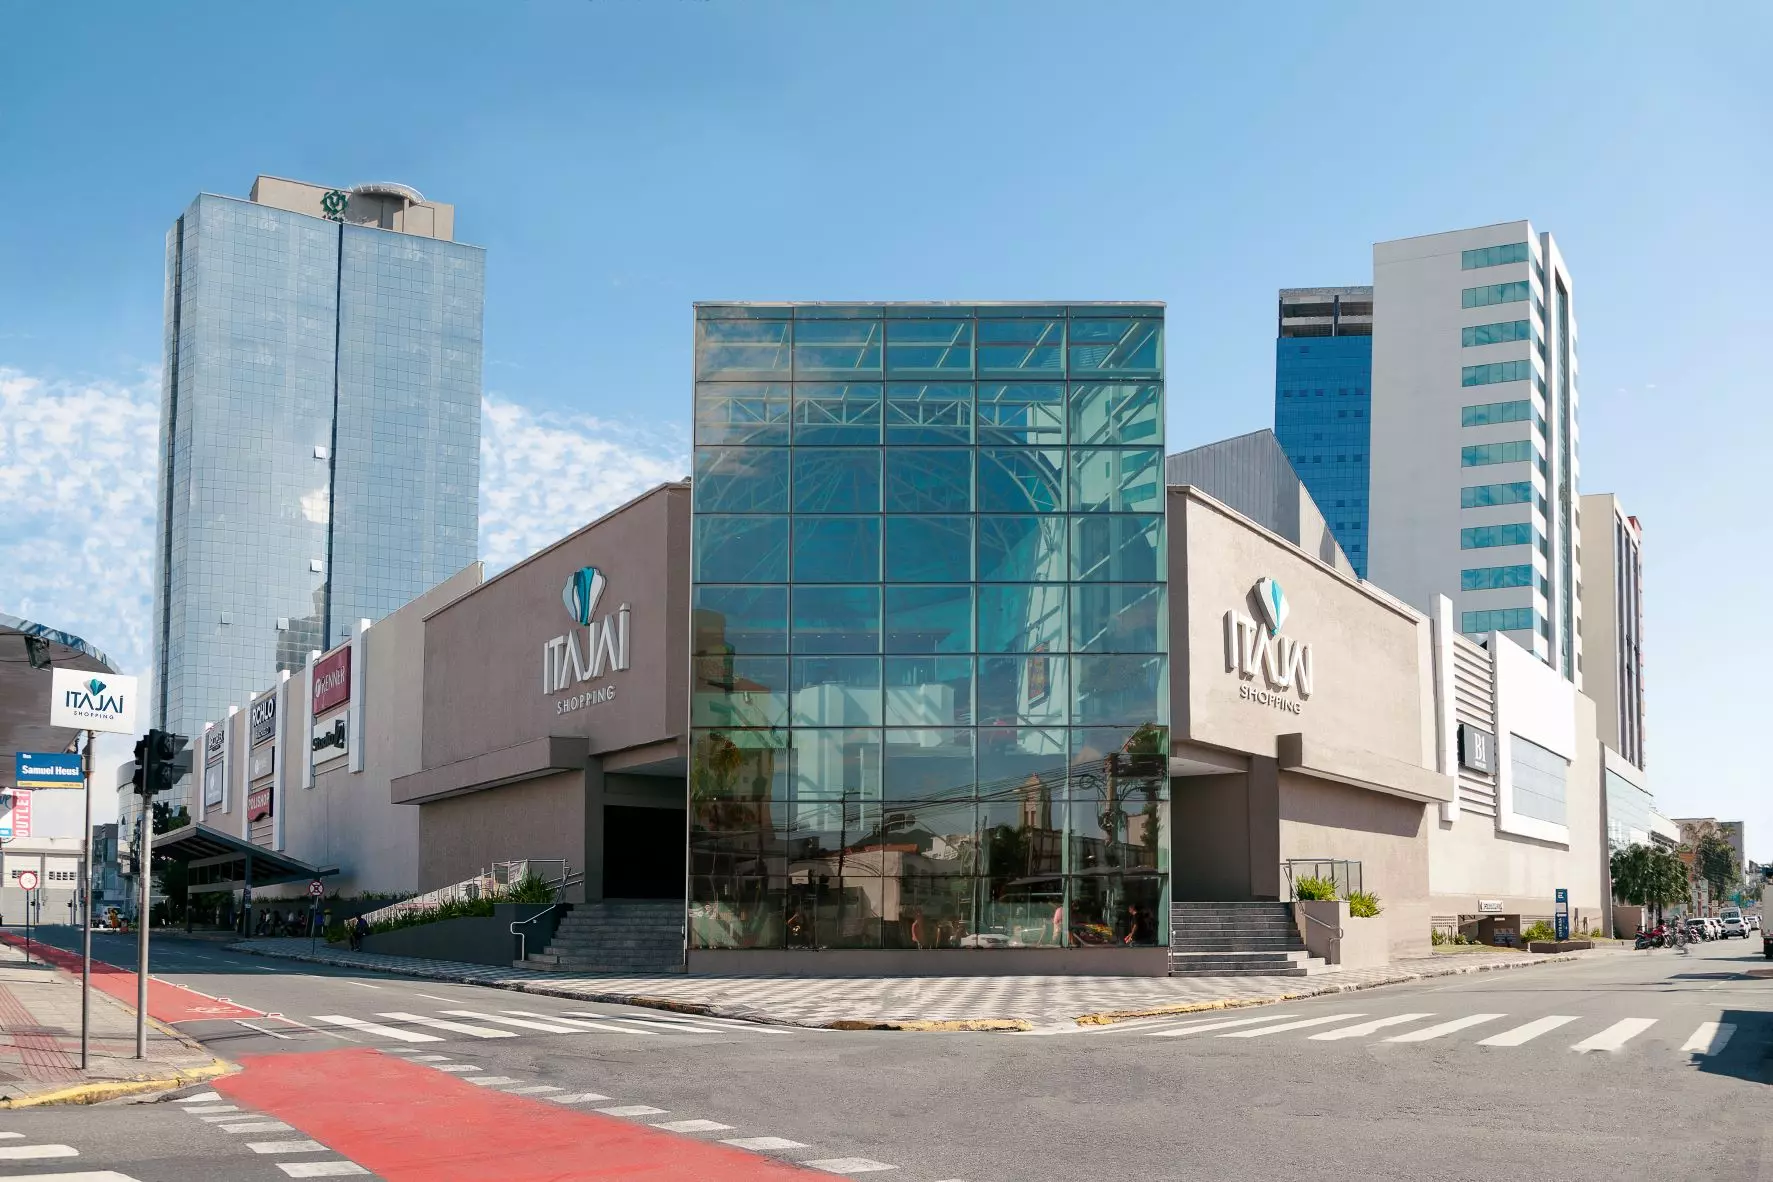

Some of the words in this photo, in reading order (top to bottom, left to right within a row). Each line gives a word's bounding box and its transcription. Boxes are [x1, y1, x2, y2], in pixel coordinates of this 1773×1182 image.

[321, 666, 345, 693] RENNER
[253, 698, 274, 727] RCHLO
[556, 685, 616, 715] SHOPPING
[1240, 684, 1301, 715] SHOPPING
[73, 710, 114, 720] SHOPPING
[22, 764, 54, 775] Samuel
[55, 765, 80, 776] Heusi
[15, 791, 29, 837] OUTLET
